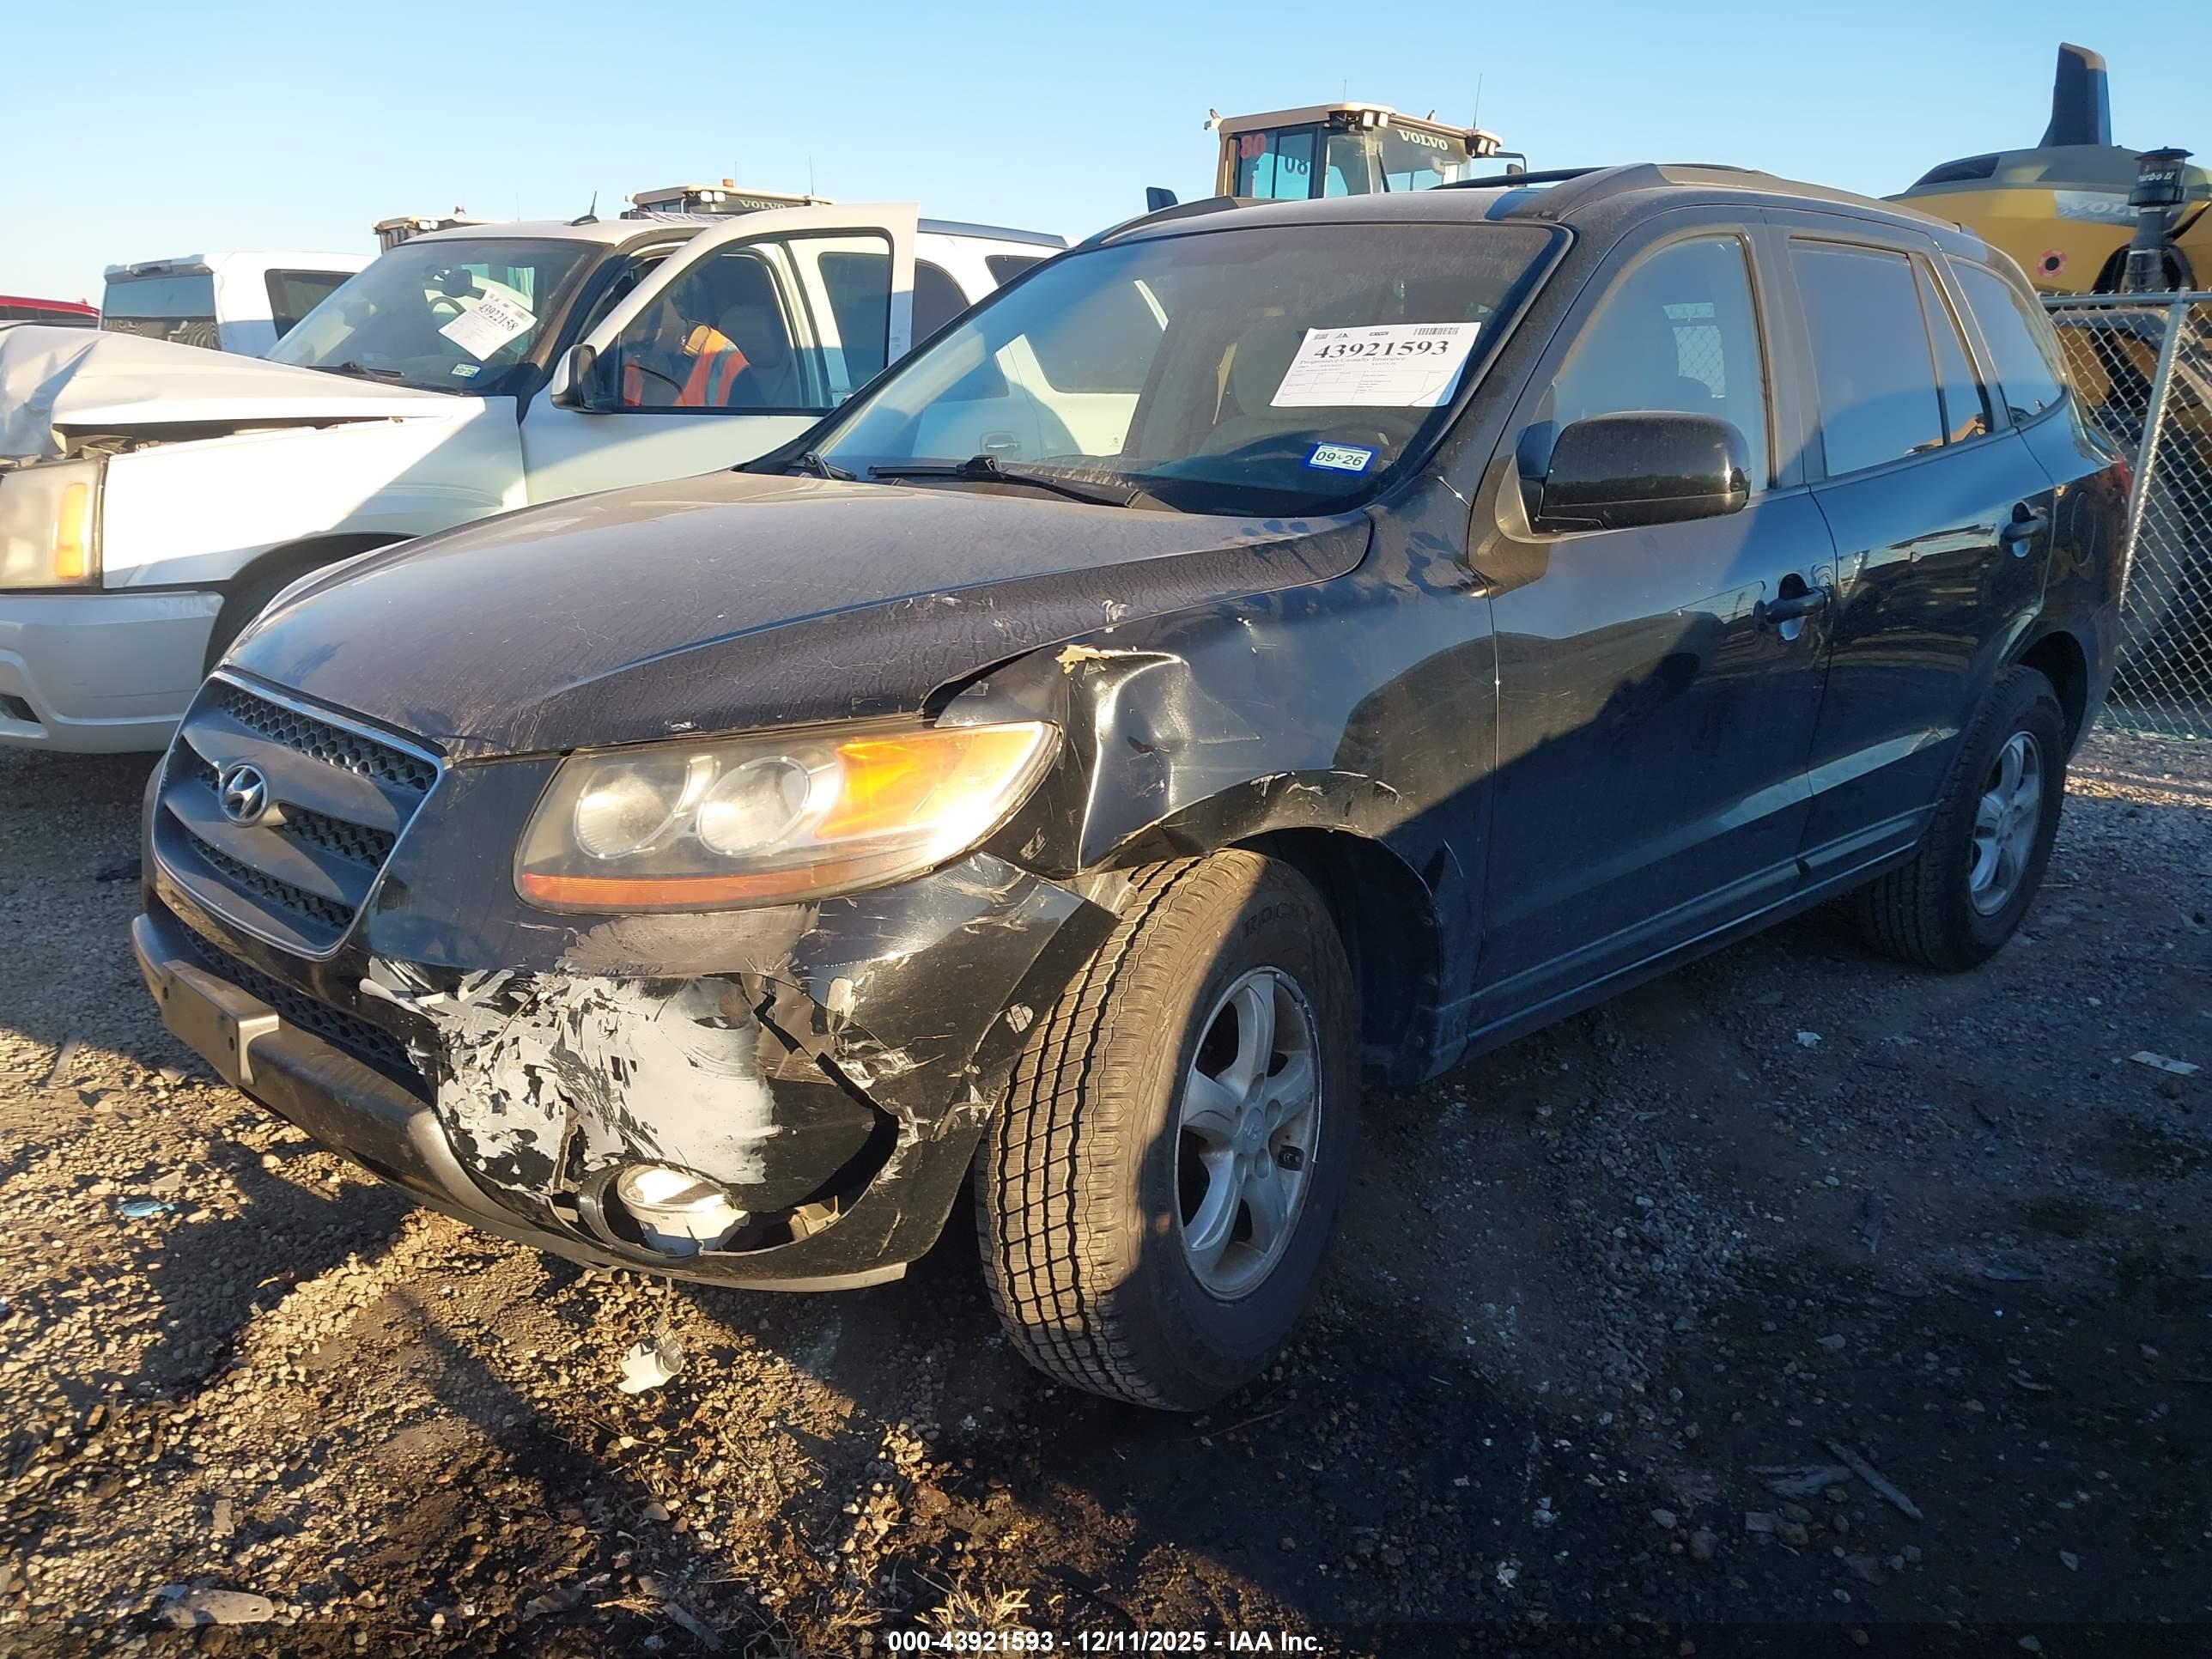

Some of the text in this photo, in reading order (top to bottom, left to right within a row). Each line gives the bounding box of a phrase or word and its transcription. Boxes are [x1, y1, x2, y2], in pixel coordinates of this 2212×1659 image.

[1240, 134, 1267, 159] 80
[1397, 130, 1449, 151] VOLVO
[478, 303, 520, 331] 43922158
[1314, 341, 1449, 358] 43921593
[1316, 452, 1364, 465] 09 26
